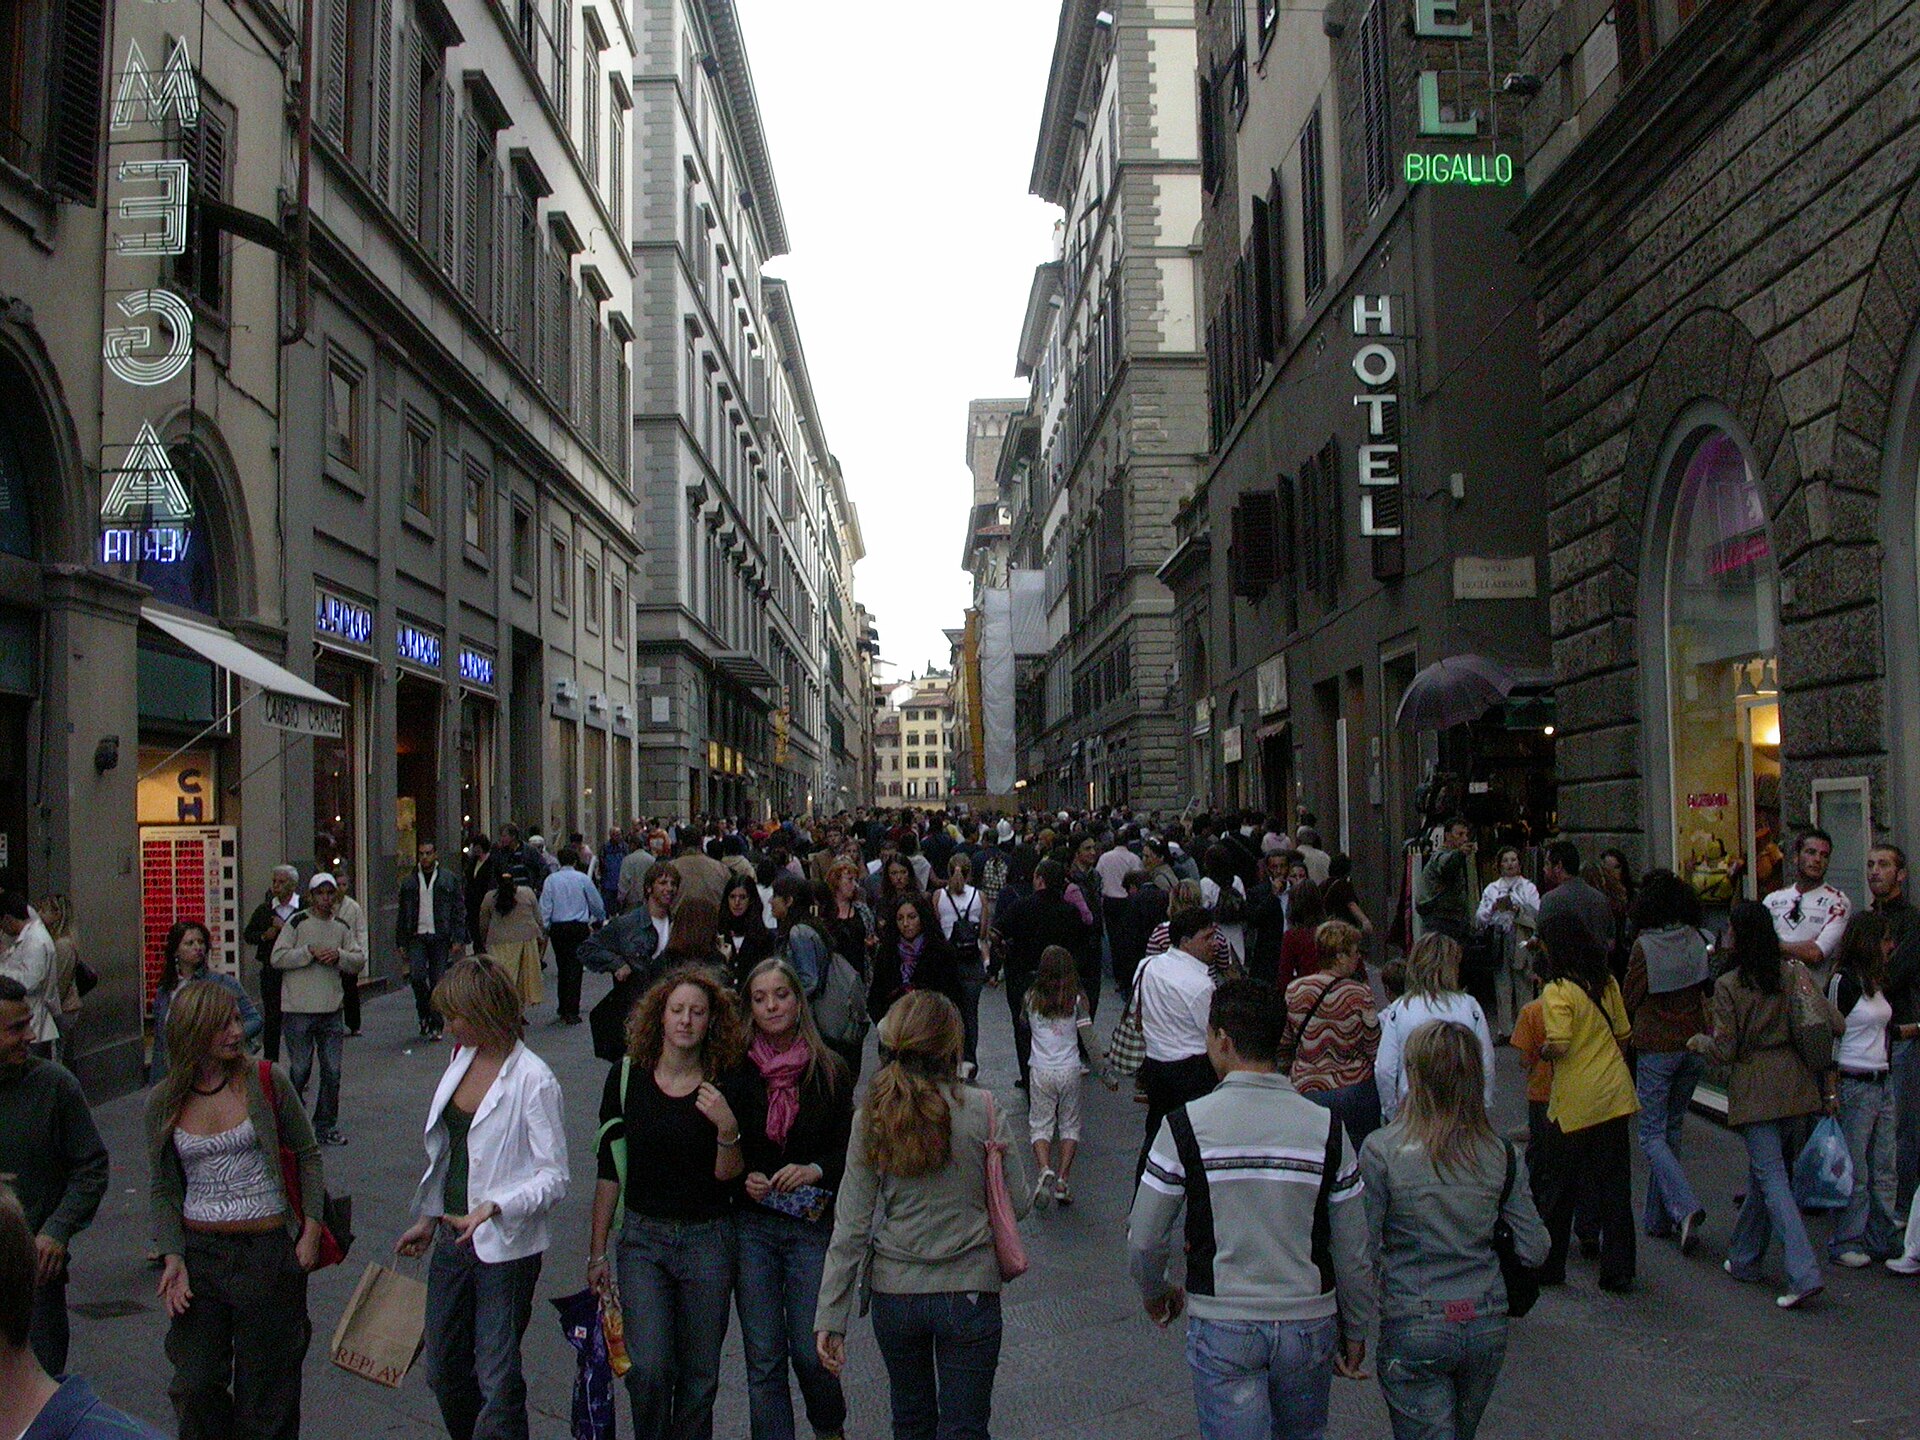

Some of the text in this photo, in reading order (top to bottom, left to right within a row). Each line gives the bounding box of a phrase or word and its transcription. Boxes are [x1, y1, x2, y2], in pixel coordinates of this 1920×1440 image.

[1405, 152, 1513, 184] BIGALLO
[1353, 295, 1402, 537] HOTEL
[334, 1346, 403, 1384] REPLAY
